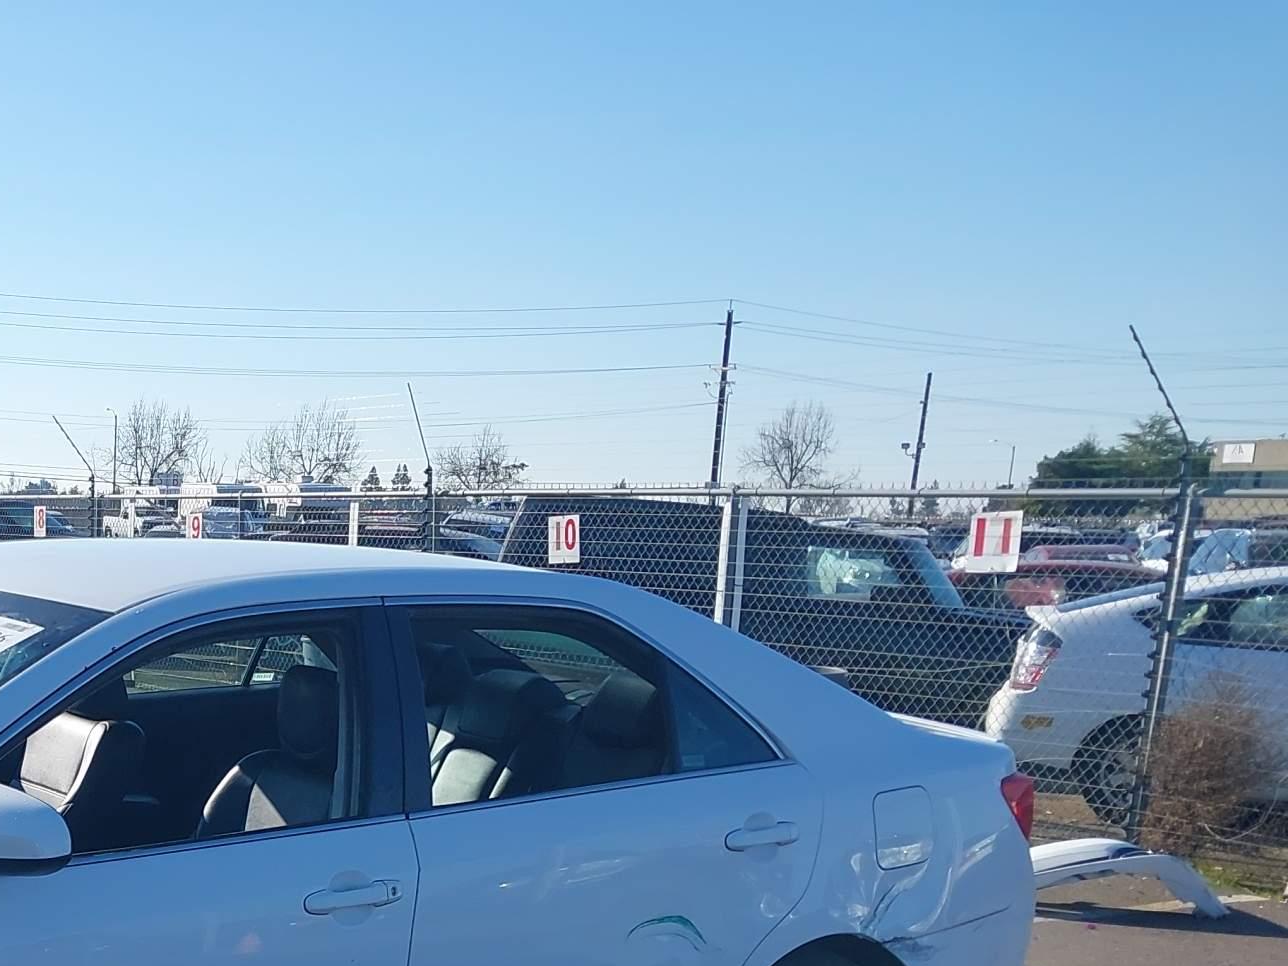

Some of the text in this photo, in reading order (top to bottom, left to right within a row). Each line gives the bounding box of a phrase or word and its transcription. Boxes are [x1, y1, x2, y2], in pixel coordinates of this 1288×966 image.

[38, 508, 44, 528] 8
[192, 516, 200, 538] 9
[556, 518, 576, 550] 10
[974, 517, 1012, 557] 11
